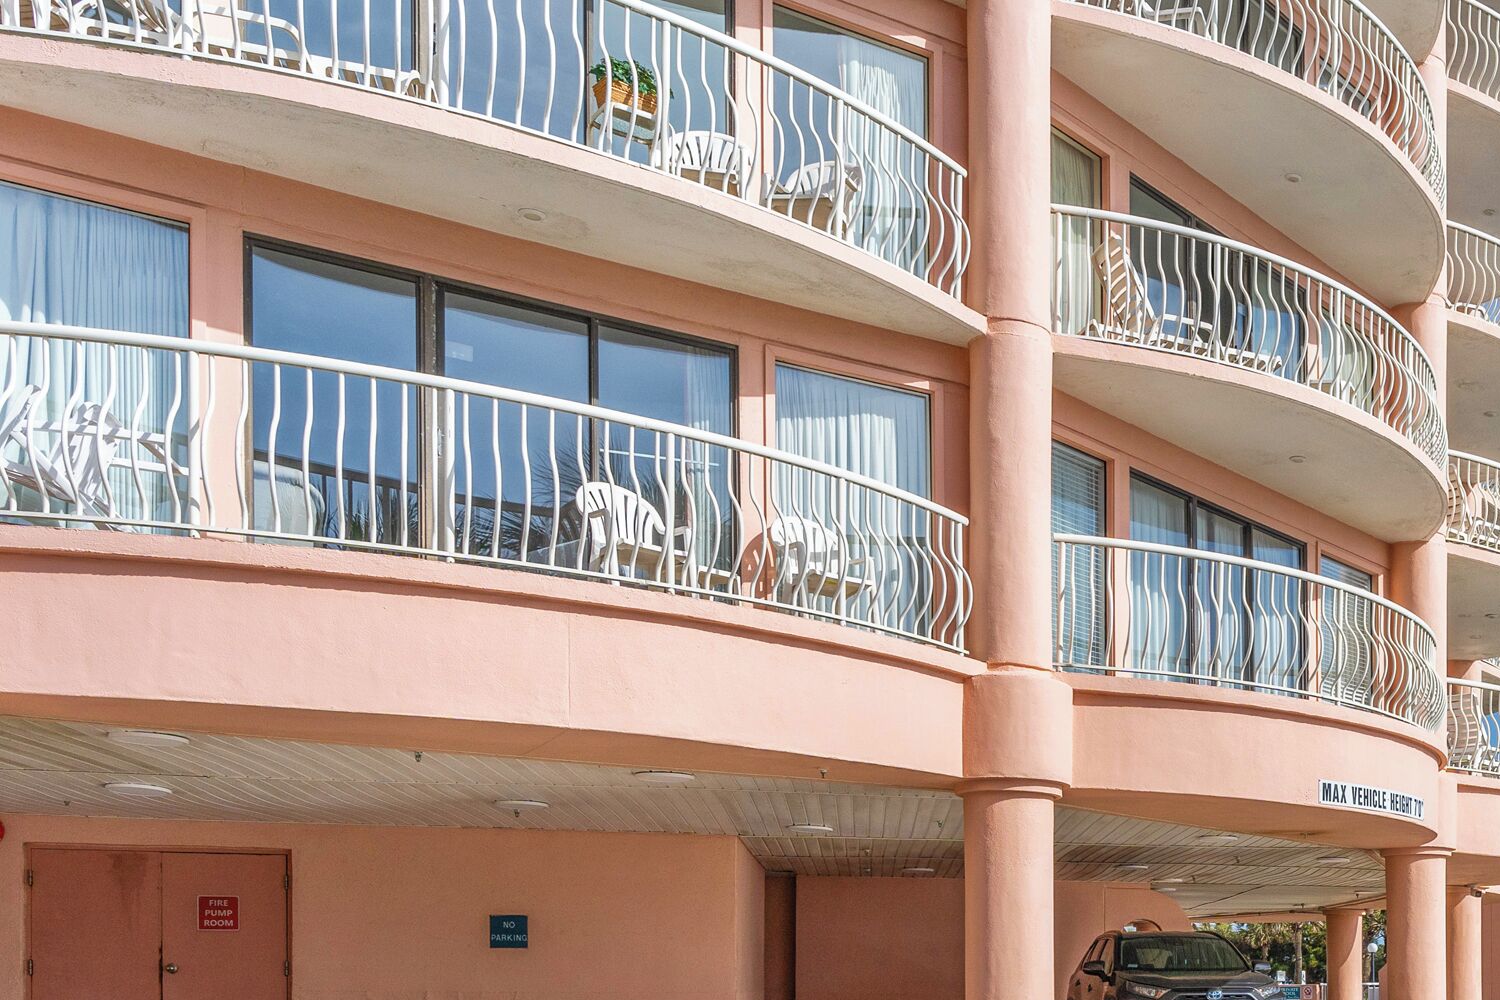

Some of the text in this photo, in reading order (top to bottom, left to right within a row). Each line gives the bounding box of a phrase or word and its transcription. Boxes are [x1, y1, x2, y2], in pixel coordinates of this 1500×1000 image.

[1322, 782, 1347, 804] MAX
[1351, 786, 1387, 810] VEHICLE
[1390, 792, 1413, 816] HEIGHT
[209, 899, 229, 907] FIRE
[204, 909, 233, 917] PUMP
[203, 919, 234, 927] ROOM
[503, 921, 516, 929] NO
[491, 934, 528, 942] PARKING
